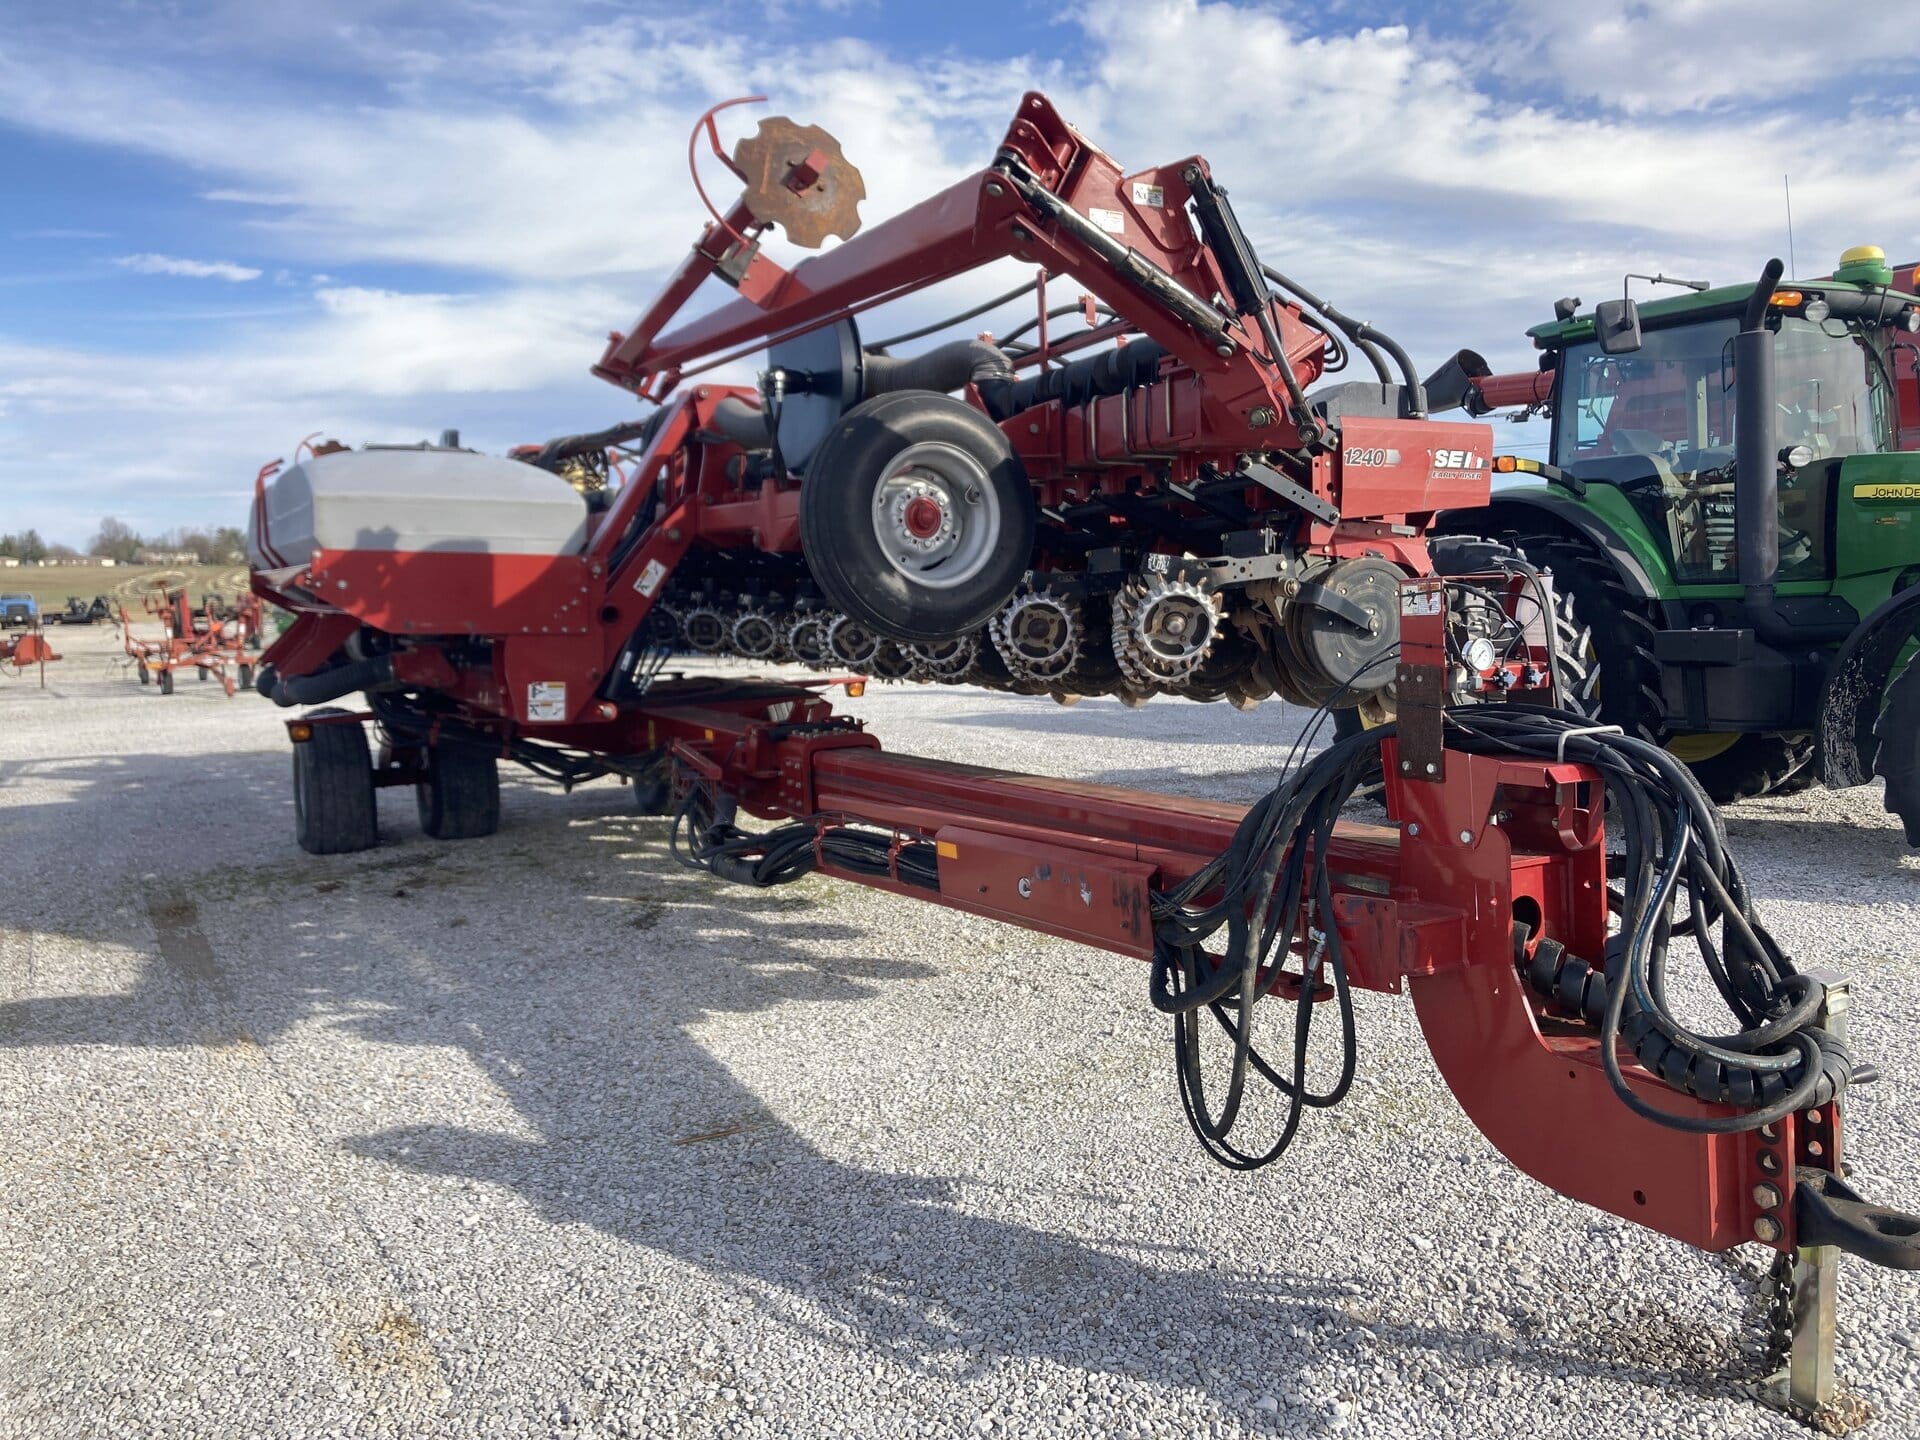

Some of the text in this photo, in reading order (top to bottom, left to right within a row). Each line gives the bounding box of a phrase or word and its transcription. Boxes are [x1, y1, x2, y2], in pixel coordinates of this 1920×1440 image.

[1344, 447, 1385, 467] 1240
[1432, 471, 1457, 479] EARLY
[1872, 487, 1903, 497] JOHN
